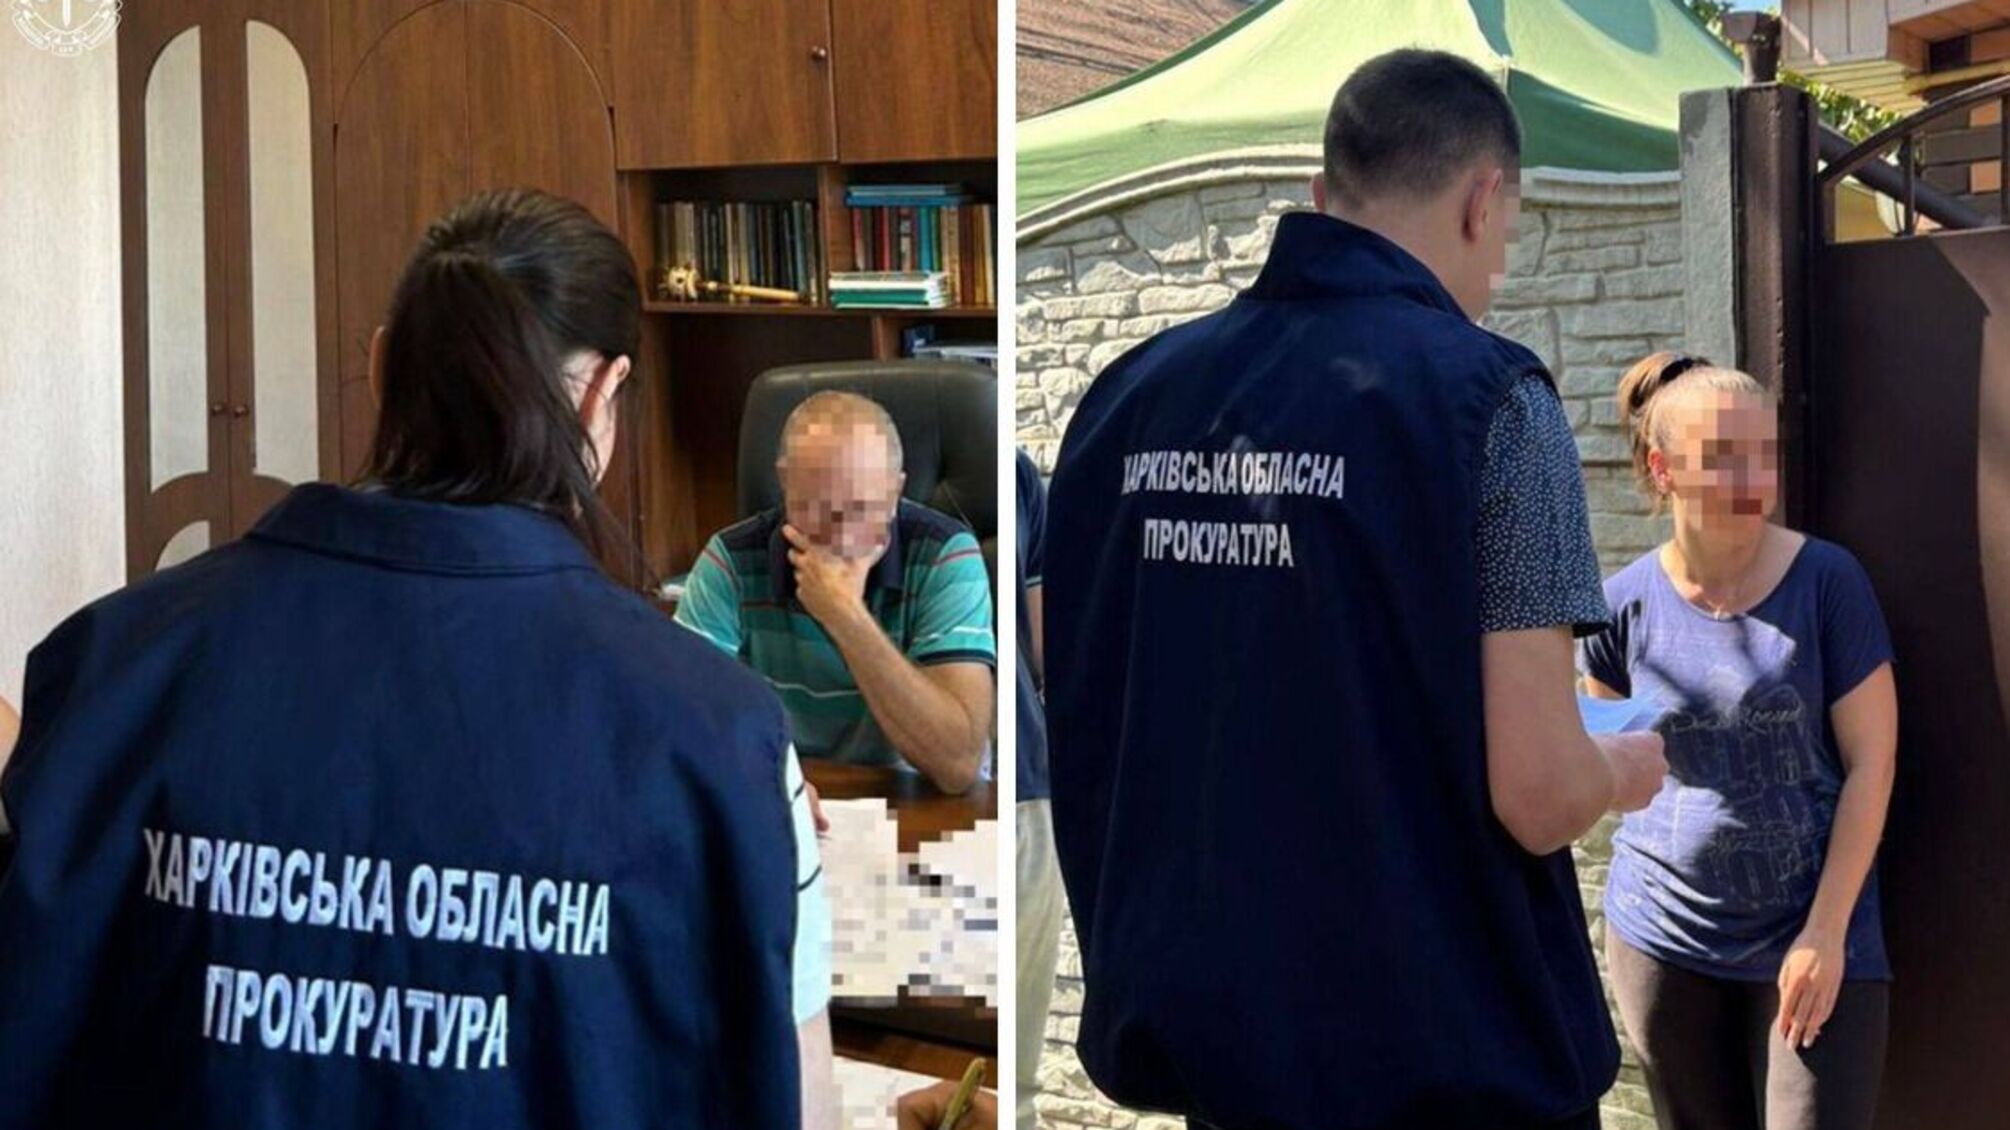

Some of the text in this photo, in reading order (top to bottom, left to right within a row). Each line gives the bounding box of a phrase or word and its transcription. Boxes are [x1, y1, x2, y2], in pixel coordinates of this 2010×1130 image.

[1241, 452, 1345, 499] ОБЛАСНА
[1143, 518, 1295, 567] ПРОКУРАТУРА
[144, 827, 611, 955] ХАРКІВСЬКА ОБЛАСНА
[203, 964, 509, 1069] ПРОКУРАТУРА
